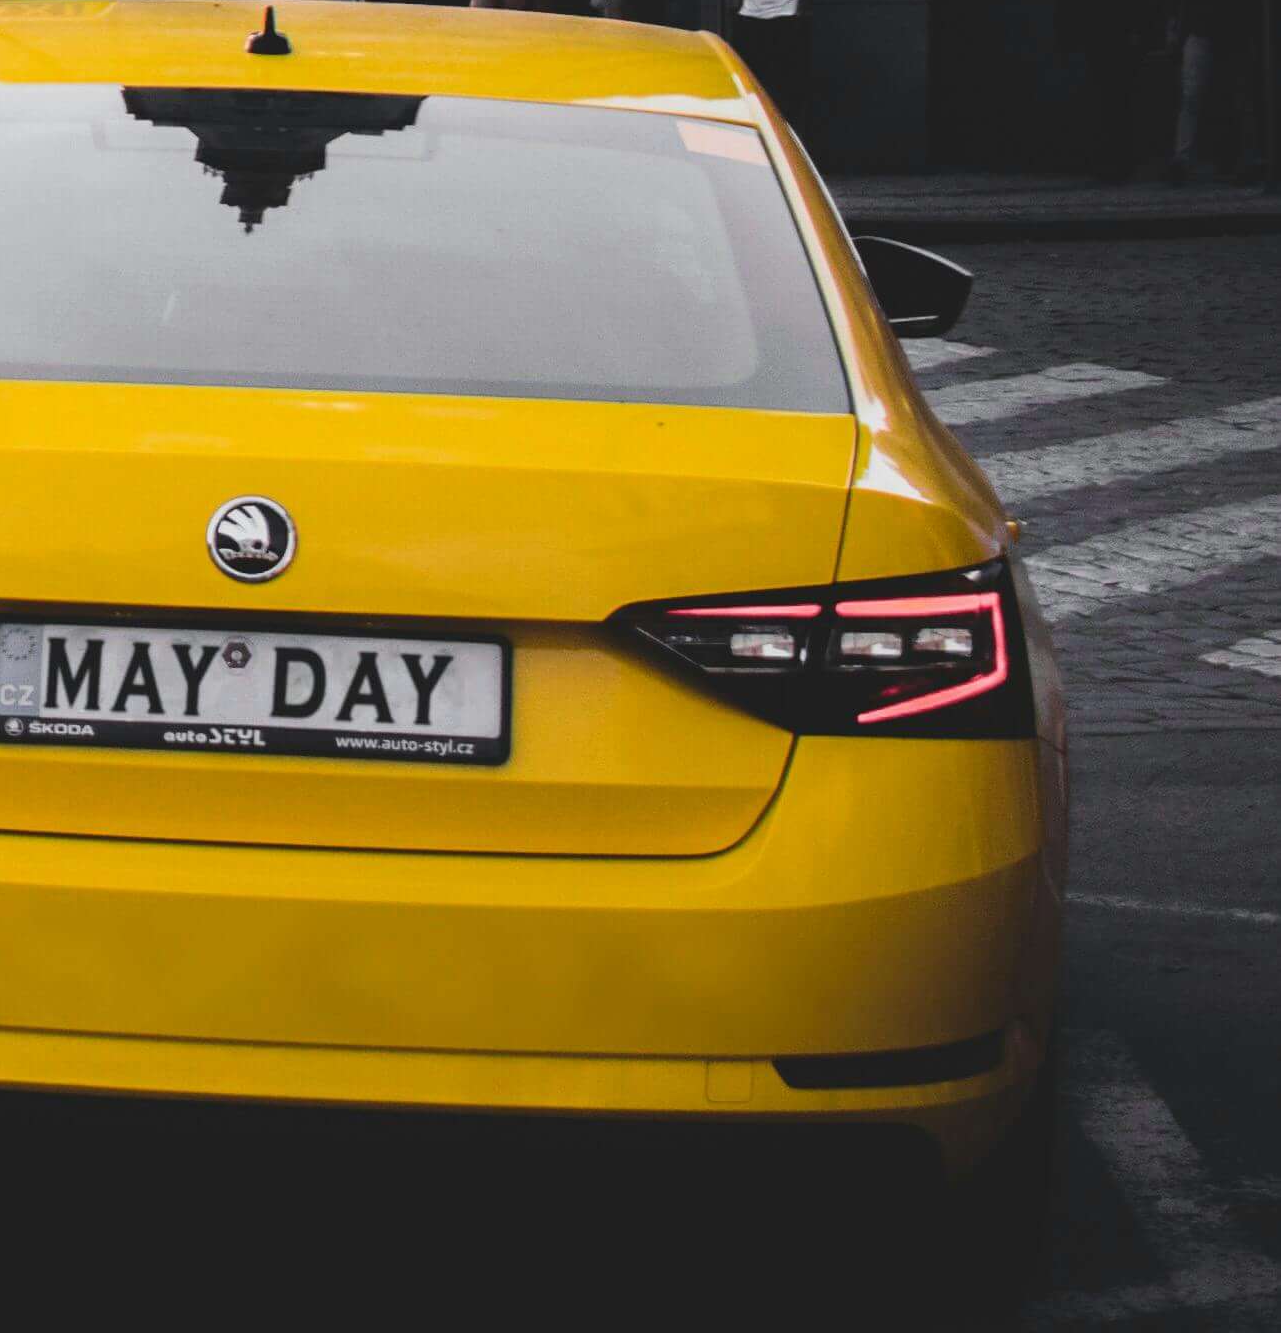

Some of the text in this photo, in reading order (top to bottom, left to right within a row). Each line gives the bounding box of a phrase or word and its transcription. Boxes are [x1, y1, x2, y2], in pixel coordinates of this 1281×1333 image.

[43, 637, 454, 726] MAY DAY
[0, 684, 35, 706] CZ
[335, 736, 475, 756] www.auto-styl.cz
